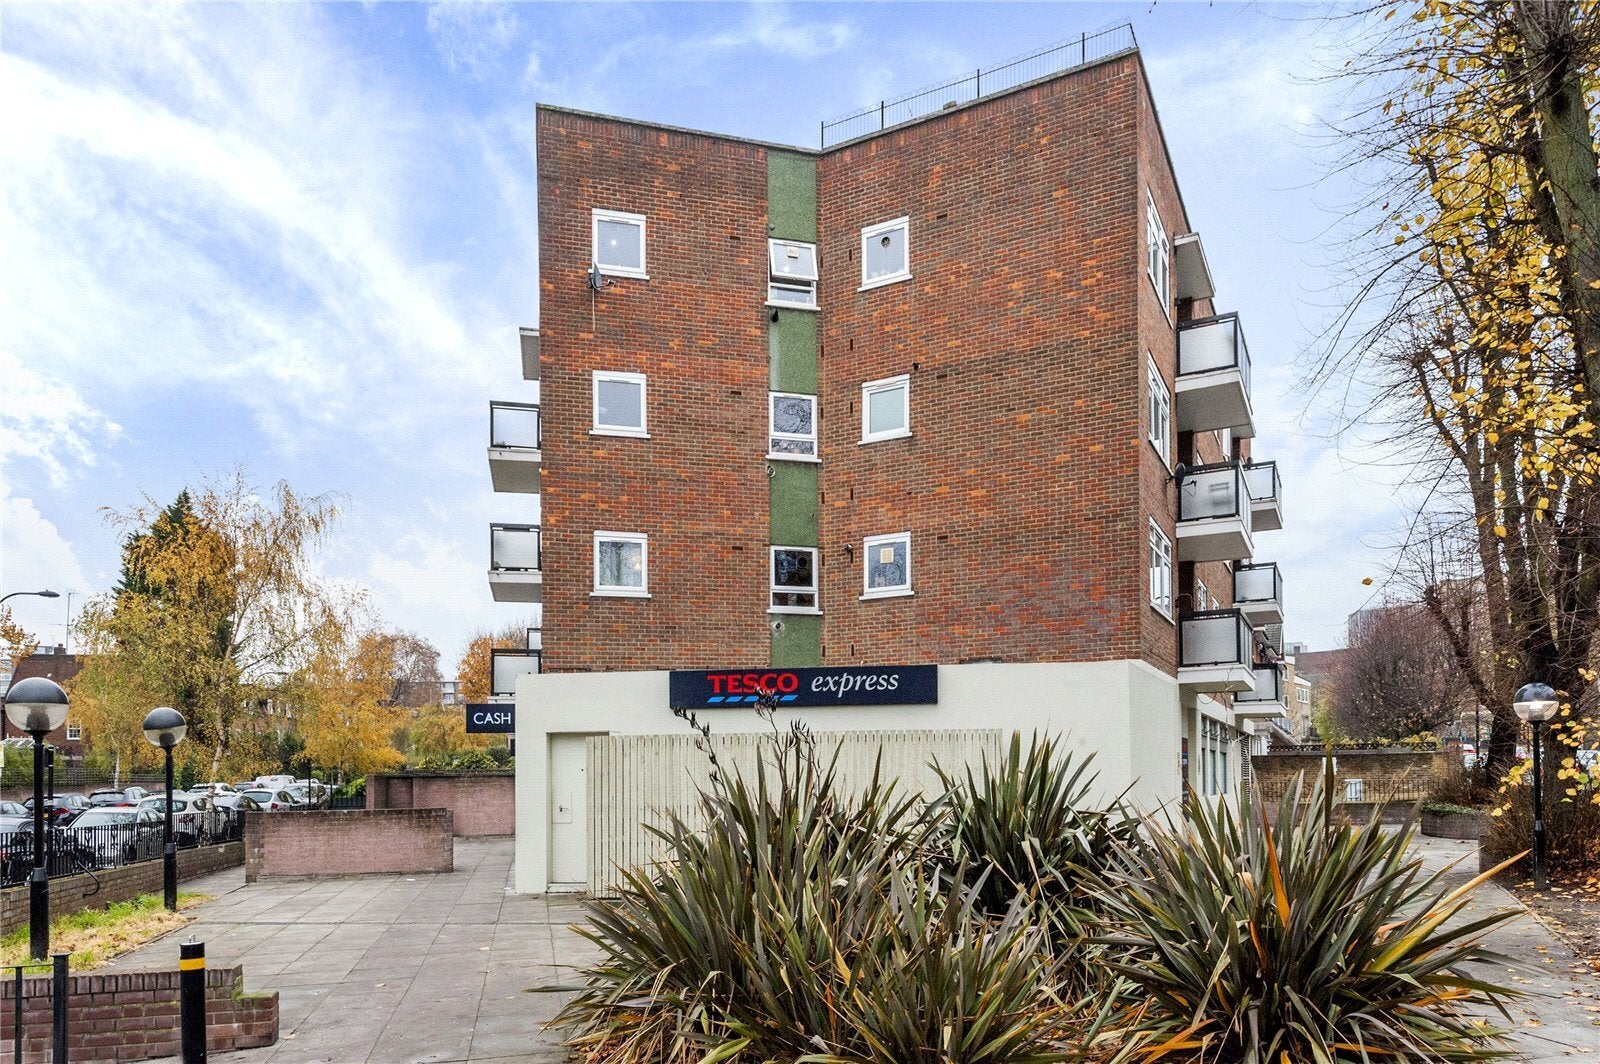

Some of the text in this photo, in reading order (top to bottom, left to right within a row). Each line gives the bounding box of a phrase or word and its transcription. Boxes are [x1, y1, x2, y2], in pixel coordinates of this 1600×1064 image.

[707, 672, 899, 698] TESCO express
[473, 712, 511, 725] CASH
